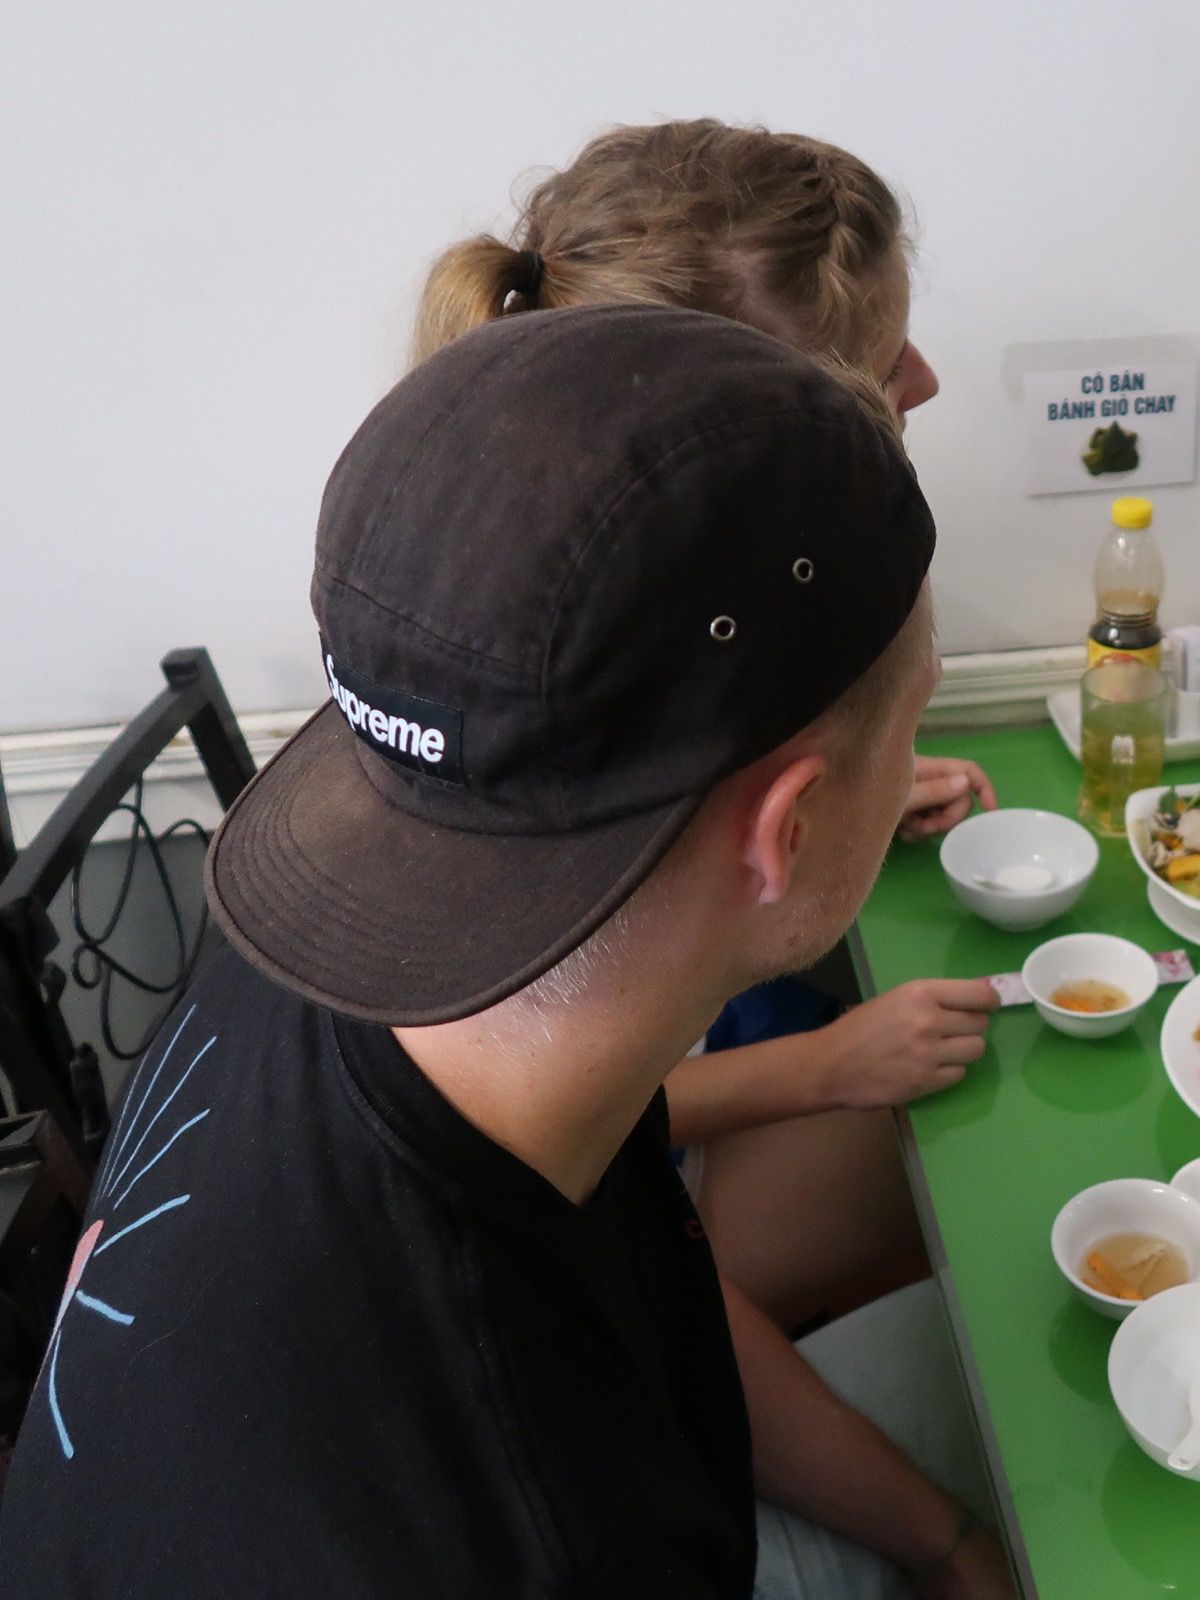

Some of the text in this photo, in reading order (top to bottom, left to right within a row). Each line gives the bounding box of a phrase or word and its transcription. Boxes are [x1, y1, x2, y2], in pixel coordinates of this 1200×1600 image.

[1081, 370, 1145, 394] CÓ BÁN
[1048, 398, 1095, 420] BÁNH
[1134, 395, 1176, 414] CHAY
[326, 654, 445, 763] Supreme
